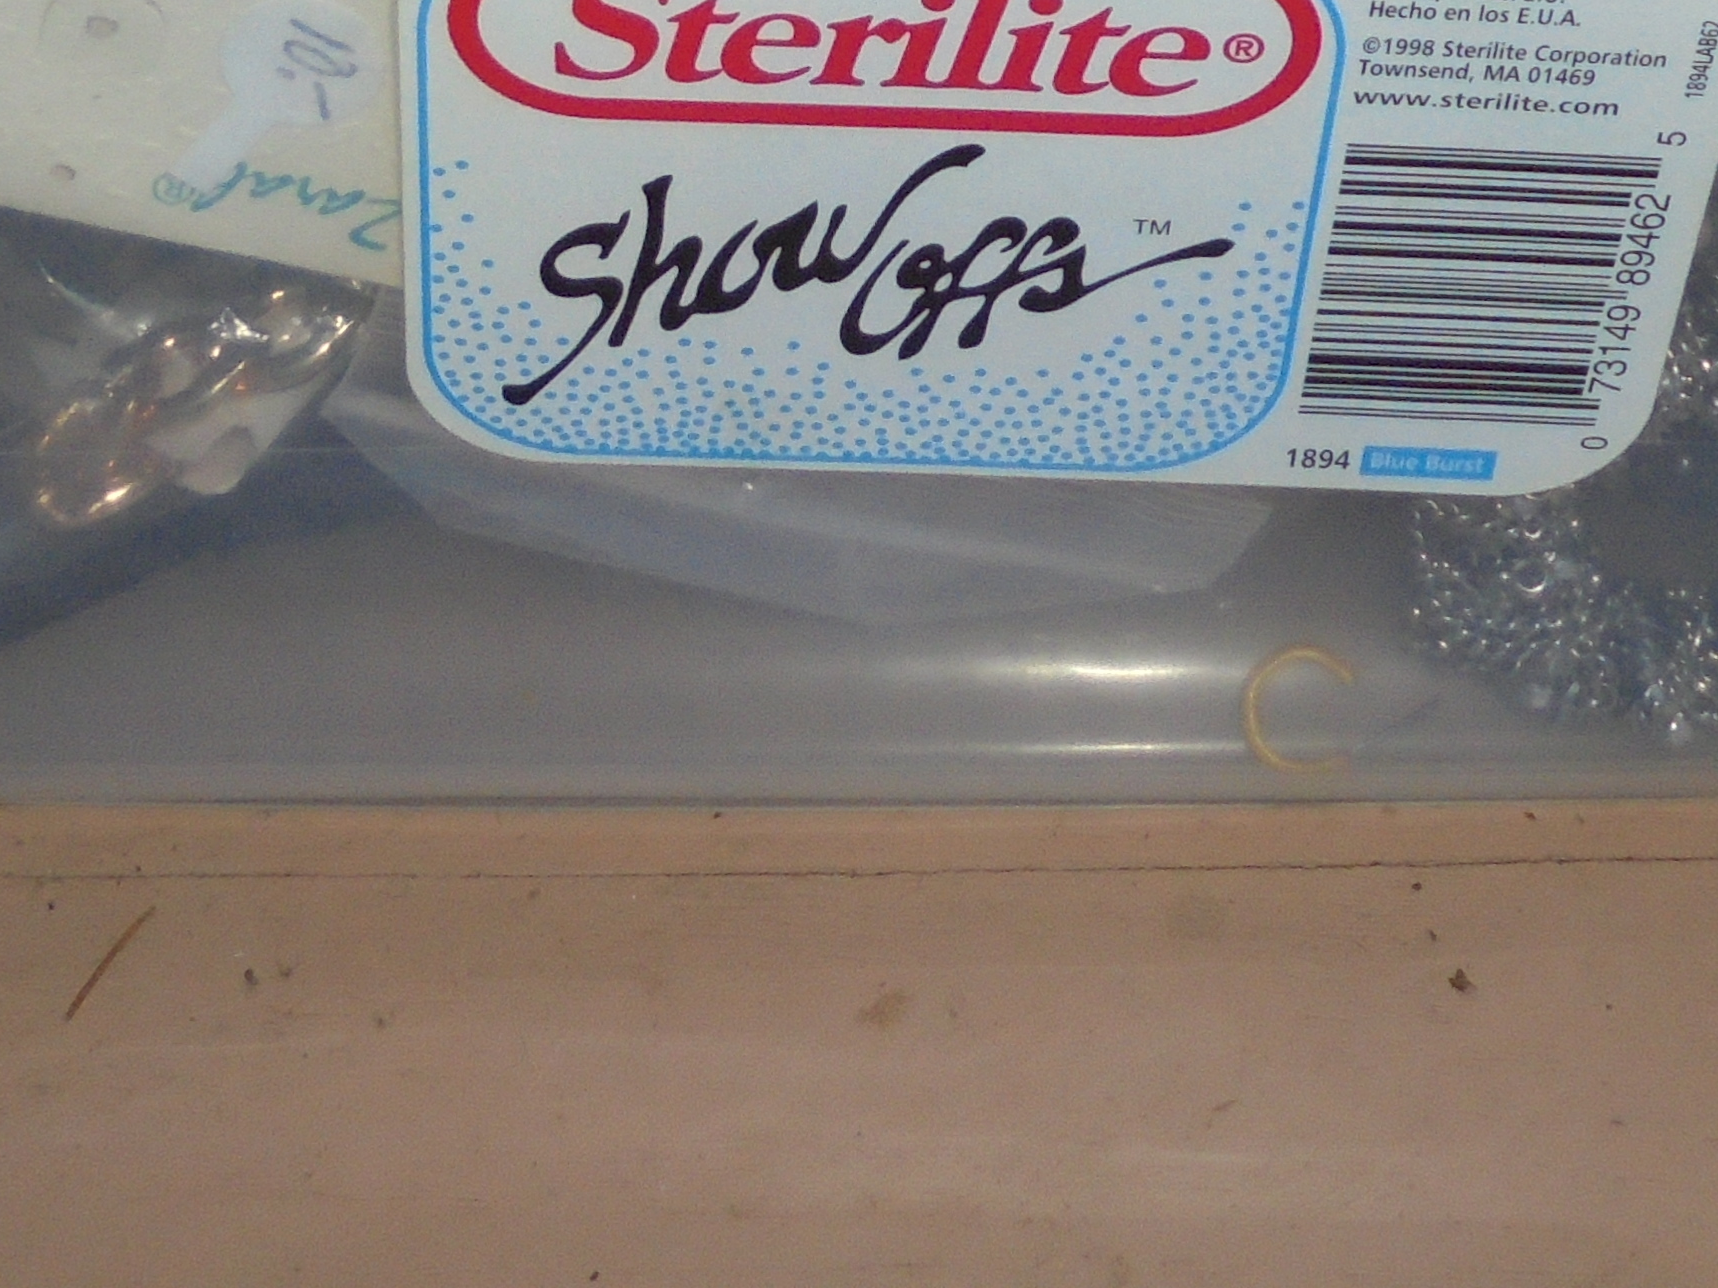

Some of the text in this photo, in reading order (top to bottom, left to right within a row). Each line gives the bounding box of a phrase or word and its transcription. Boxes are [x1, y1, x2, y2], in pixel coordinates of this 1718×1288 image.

[1369, 1, 1582, 27] Hecho en los E.U.A.
[1441, 40, 1527, 61] Sterilite
[1534, 45, 1667, 69] Corporation
[1358, 58, 1596, 86] Townsend, MA 01469
[1353, 90, 1619, 117] www.sterilite.com
[1581, 131, 1688, 450] 0 73149 89462 5
[1286, 447, 1351, 470] 1894
[1371, 452, 1418, 470] Blue
